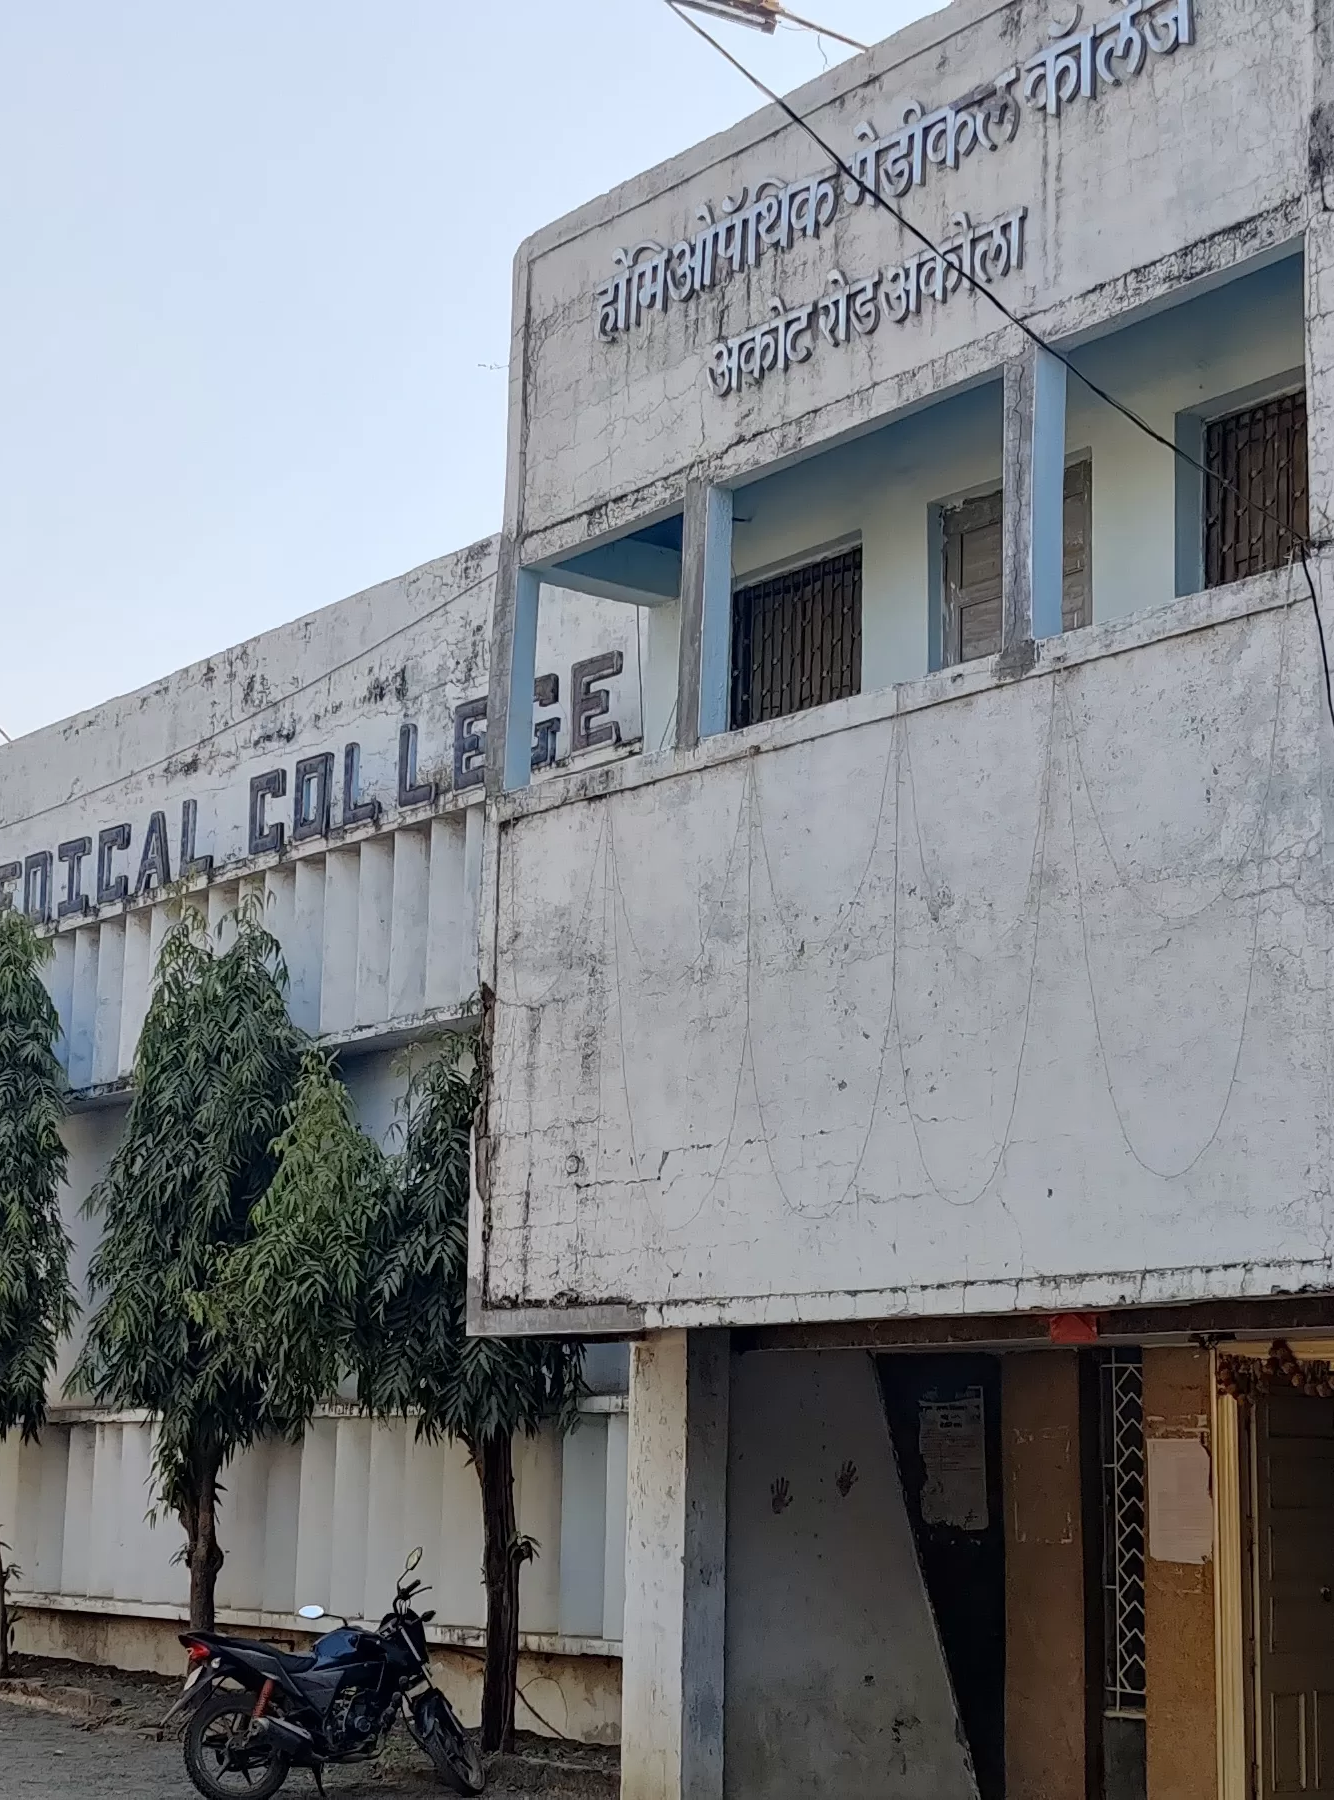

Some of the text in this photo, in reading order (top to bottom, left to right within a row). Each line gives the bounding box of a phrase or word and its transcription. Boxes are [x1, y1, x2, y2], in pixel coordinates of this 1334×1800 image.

[843, 66, 1021, 207] मेडीकल
[1022, 0, 1196, 118] कॉलज
[706, 205, 1029, 397] अकोट रोड अकोला
[248, 649, 624, 856] COLLEGE
